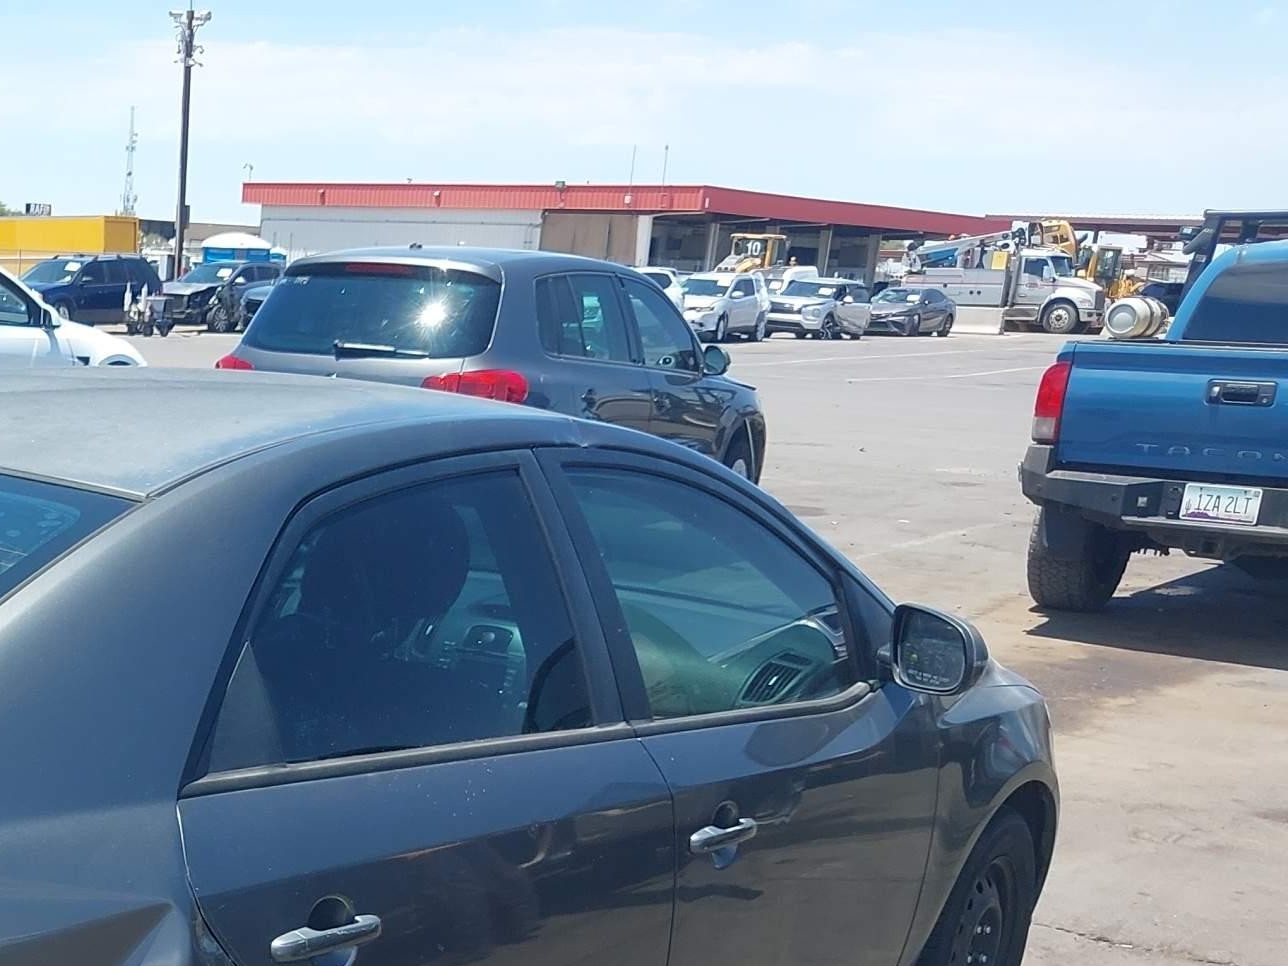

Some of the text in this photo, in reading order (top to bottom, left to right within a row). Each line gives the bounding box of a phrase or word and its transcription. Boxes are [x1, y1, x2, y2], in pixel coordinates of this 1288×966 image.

[745, 240, 762, 256] 10
[1194, 493, 1253, 515] 1ZA 2LT
